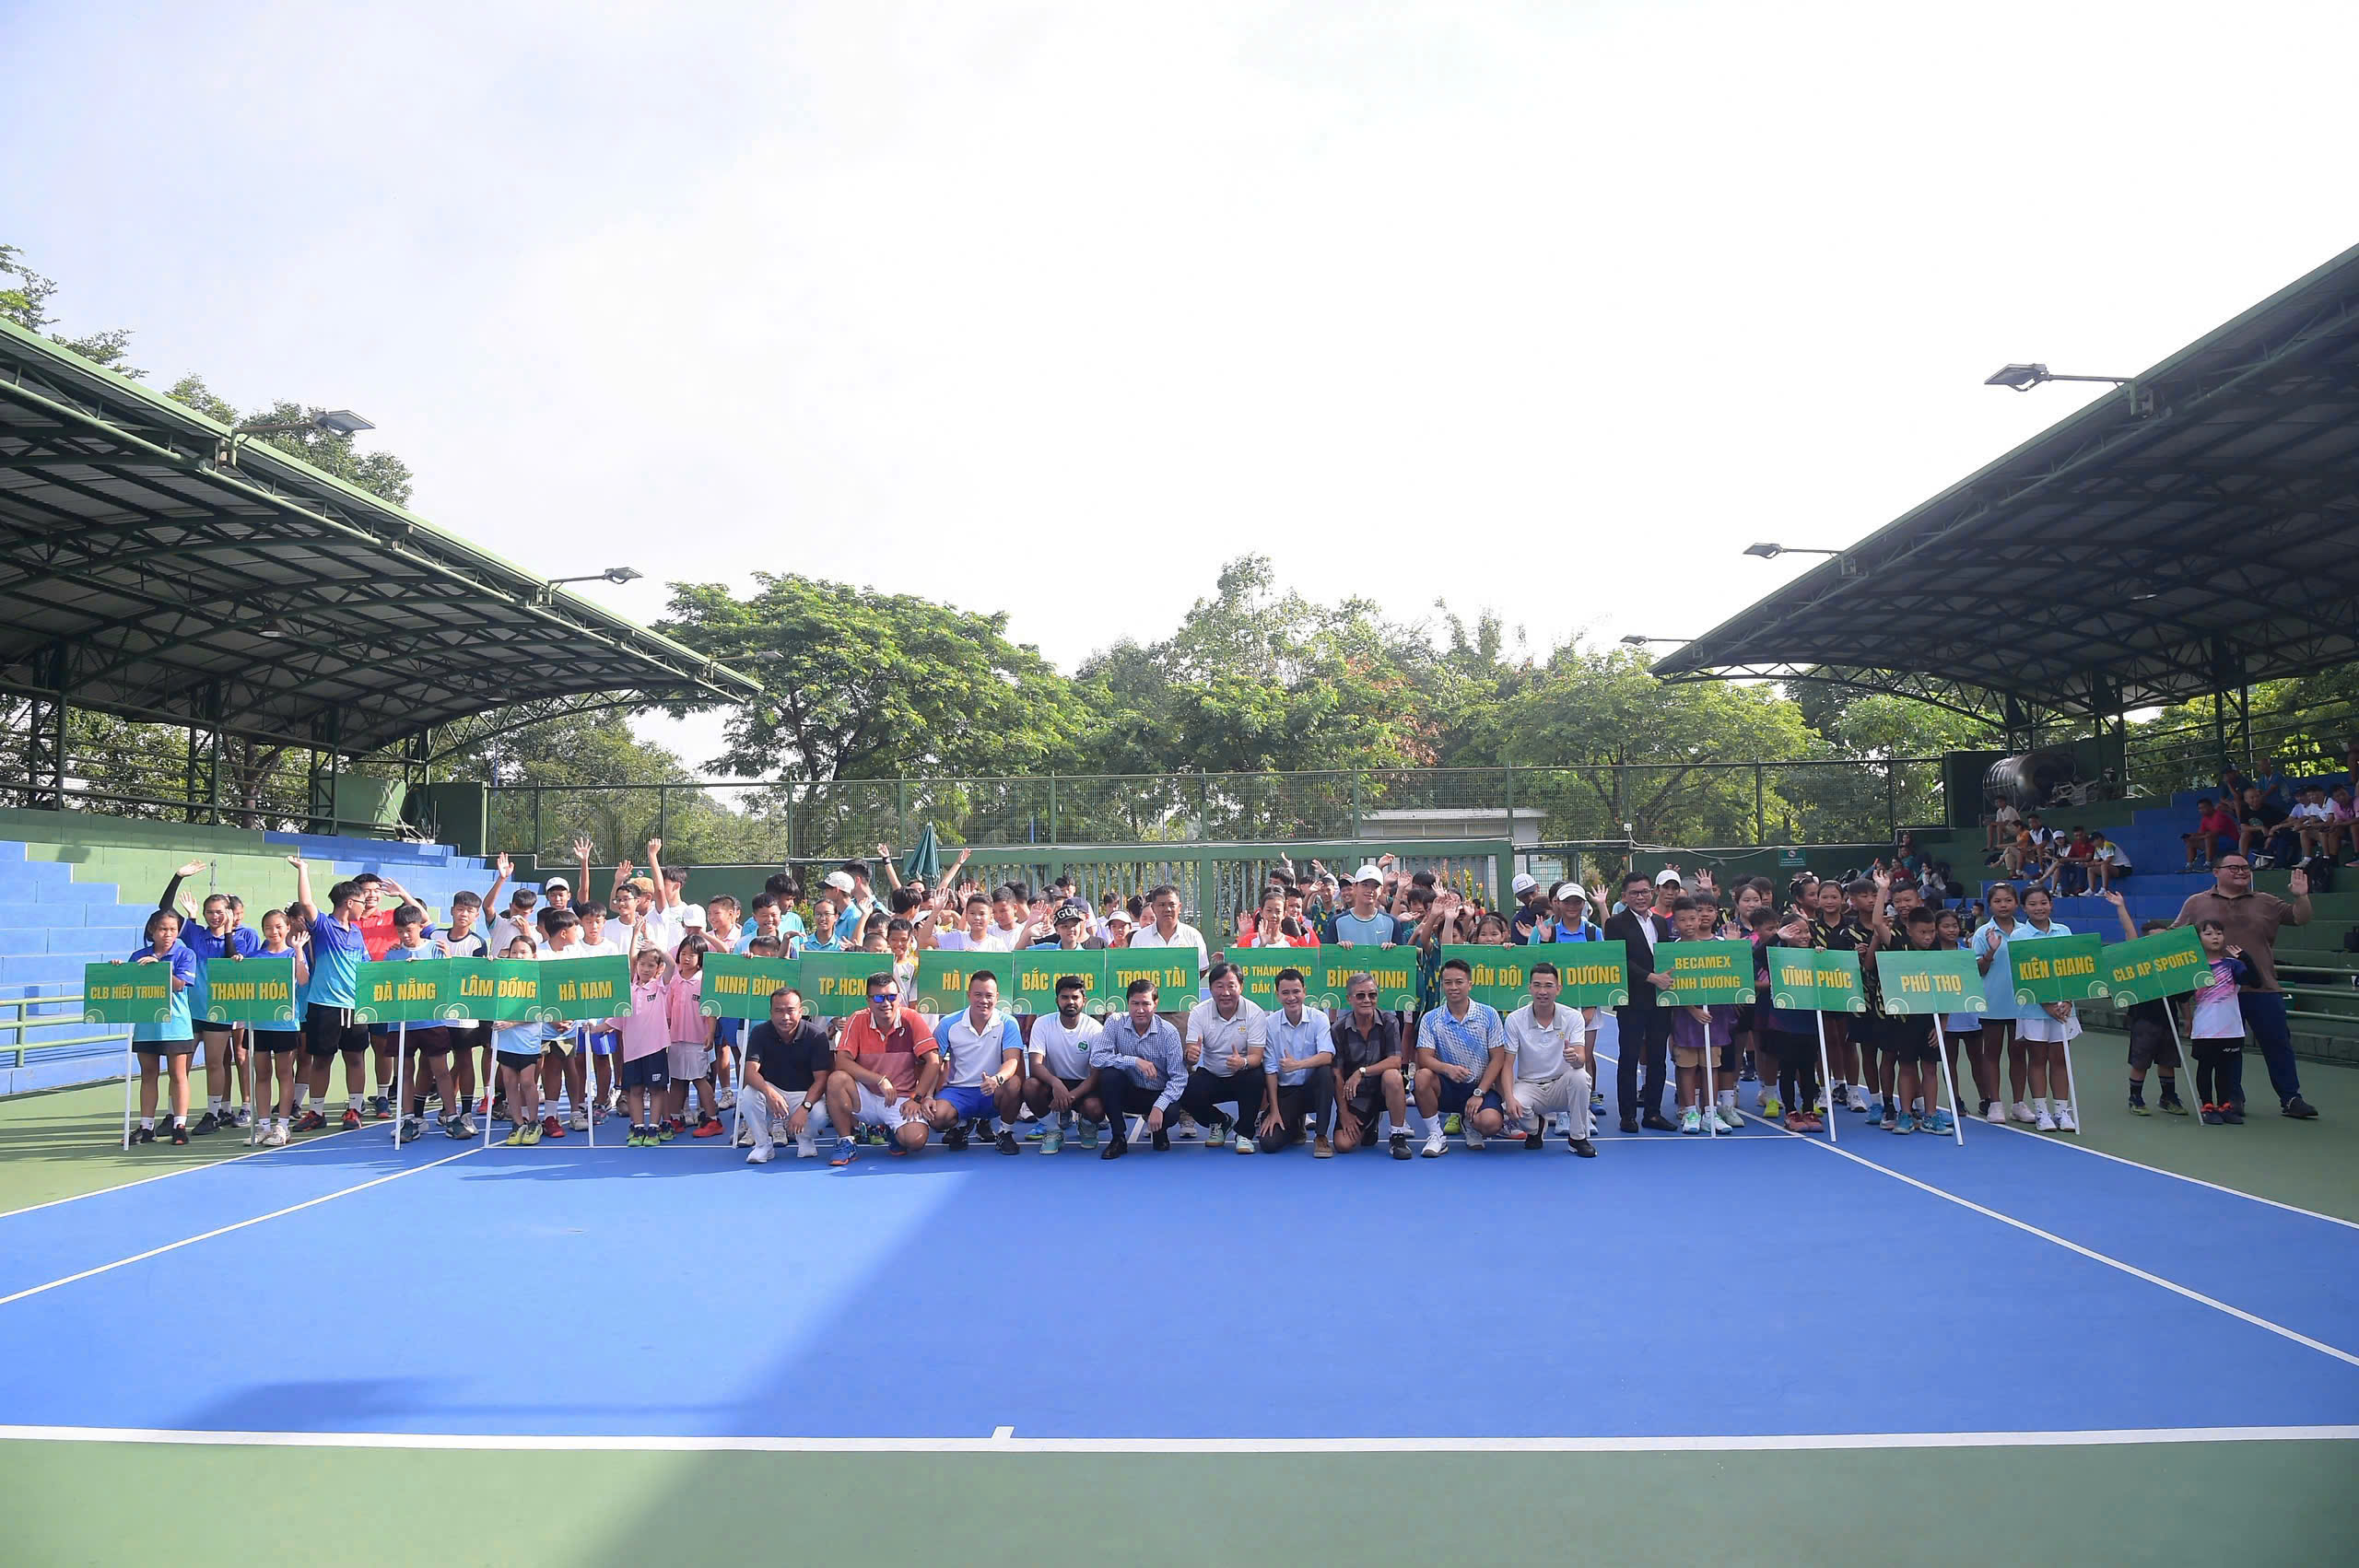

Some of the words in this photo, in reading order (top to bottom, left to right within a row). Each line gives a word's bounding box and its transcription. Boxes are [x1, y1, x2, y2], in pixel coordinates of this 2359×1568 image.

[1250, 964, 1284, 977] THÀNH
[1674, 955, 1731, 970] BECAMEX
[2019, 956, 2050, 980] KIÊN
[2053, 955, 2095, 977] GIANG
[2113, 965, 2135, 982] CLB
[2136, 961, 2152, 977] AP
[2154, 950, 2198, 972] SPORTS
[460, 975, 495, 997] LÂM
[714, 975, 748, 995] NINH
[942, 968, 961, 991] HÀ
[1021, 966, 1050, 991] BẮC
[1164, 965, 1187, 989] TÀI
[1326, 965, 1366, 988] BÌN
[1471, 963, 1495, 986] ÂN
[1498, 965, 1523, 991] ĐỘI
[1567, 965, 1622, 986] DƯƠNG
[1700, 975, 1741, 989] DƯƠNG
[1780, 965, 1813, 987] VĨNH
[1816, 967, 1853, 989] PHÚC
[1900, 970, 1931, 992] PHÚ
[1931, 974, 1963, 996] THỌ
[90, 987, 110, 1000] CLB
[135, 986, 166, 999] TRUNG
[210, 982, 255, 1000] THANH
[259, 978, 288, 1000] HÓA
[373, 980, 393, 1002] ĐÀ
[397, 977, 437, 1001] NẴNG
[559, 980, 577, 1001] HÀ
[580, 980, 613, 1000] NAM
